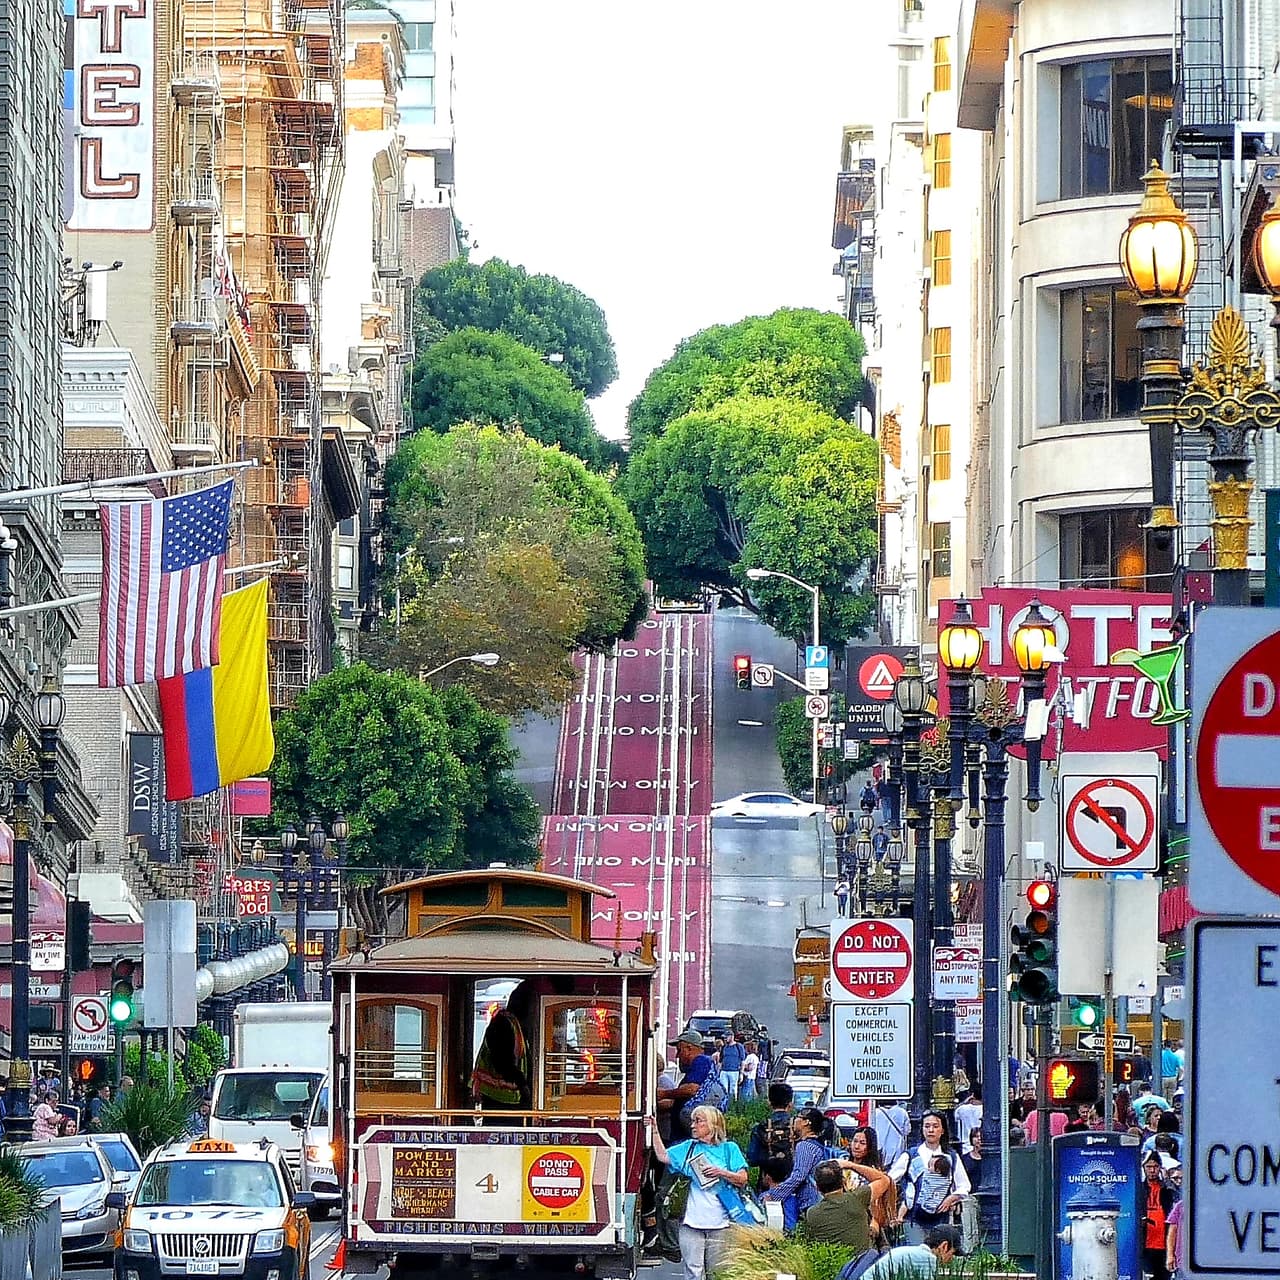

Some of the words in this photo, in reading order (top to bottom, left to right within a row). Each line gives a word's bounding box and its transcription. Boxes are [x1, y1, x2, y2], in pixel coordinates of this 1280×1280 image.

[1244, 673, 1280, 717] D
[133, 763, 151, 811] DSW
[955, 925, 967, 936] NO
[844, 936, 864, 948] DO
[872, 936, 900, 948] NOT
[936, 962, 950, 970] NO
[951, 962, 977, 970] STOPPING
[850, 971, 895, 985] ENTER
[940, 976, 955, 984] ANY
[957, 976, 975, 984] TIME
[855, 1007, 888, 1016] EXCEPT
[846, 1019, 898, 1029] COMMERCIAL
[851, 1033, 894, 1042] VEHICLES
[863, 1046, 881, 1055] AND
[851, 1059, 894, 1068] VEHICLES
[854, 1071, 890, 1081] LOADING
[1125, 1063, 1131, 1080] 2
[847, 1085, 858, 1094] ON
[865, 1085, 898, 1094] POWELL
[394, 1132, 470, 1144] MARKET
[487, 1133, 562, 1145] STREET
[195, 1143, 229, 1151] TAXI
[396, 1151, 453, 1161] POWELL
[540, 1160, 553, 1168] DO
[554, 1160, 574, 1168] NOT
[395, 1167, 454, 1176] MARKET
[545, 1168, 568, 1176] PASS
[475, 1172, 499, 1194] 4
[1096, 1175, 1128, 1183] SQUARE
[533, 1188, 560, 1196] CABLE
[562, 1189, 579, 1197] CAR
[383, 1222, 504, 1235] FISHERMANS
[524, 1223, 587, 1236] WHARF
